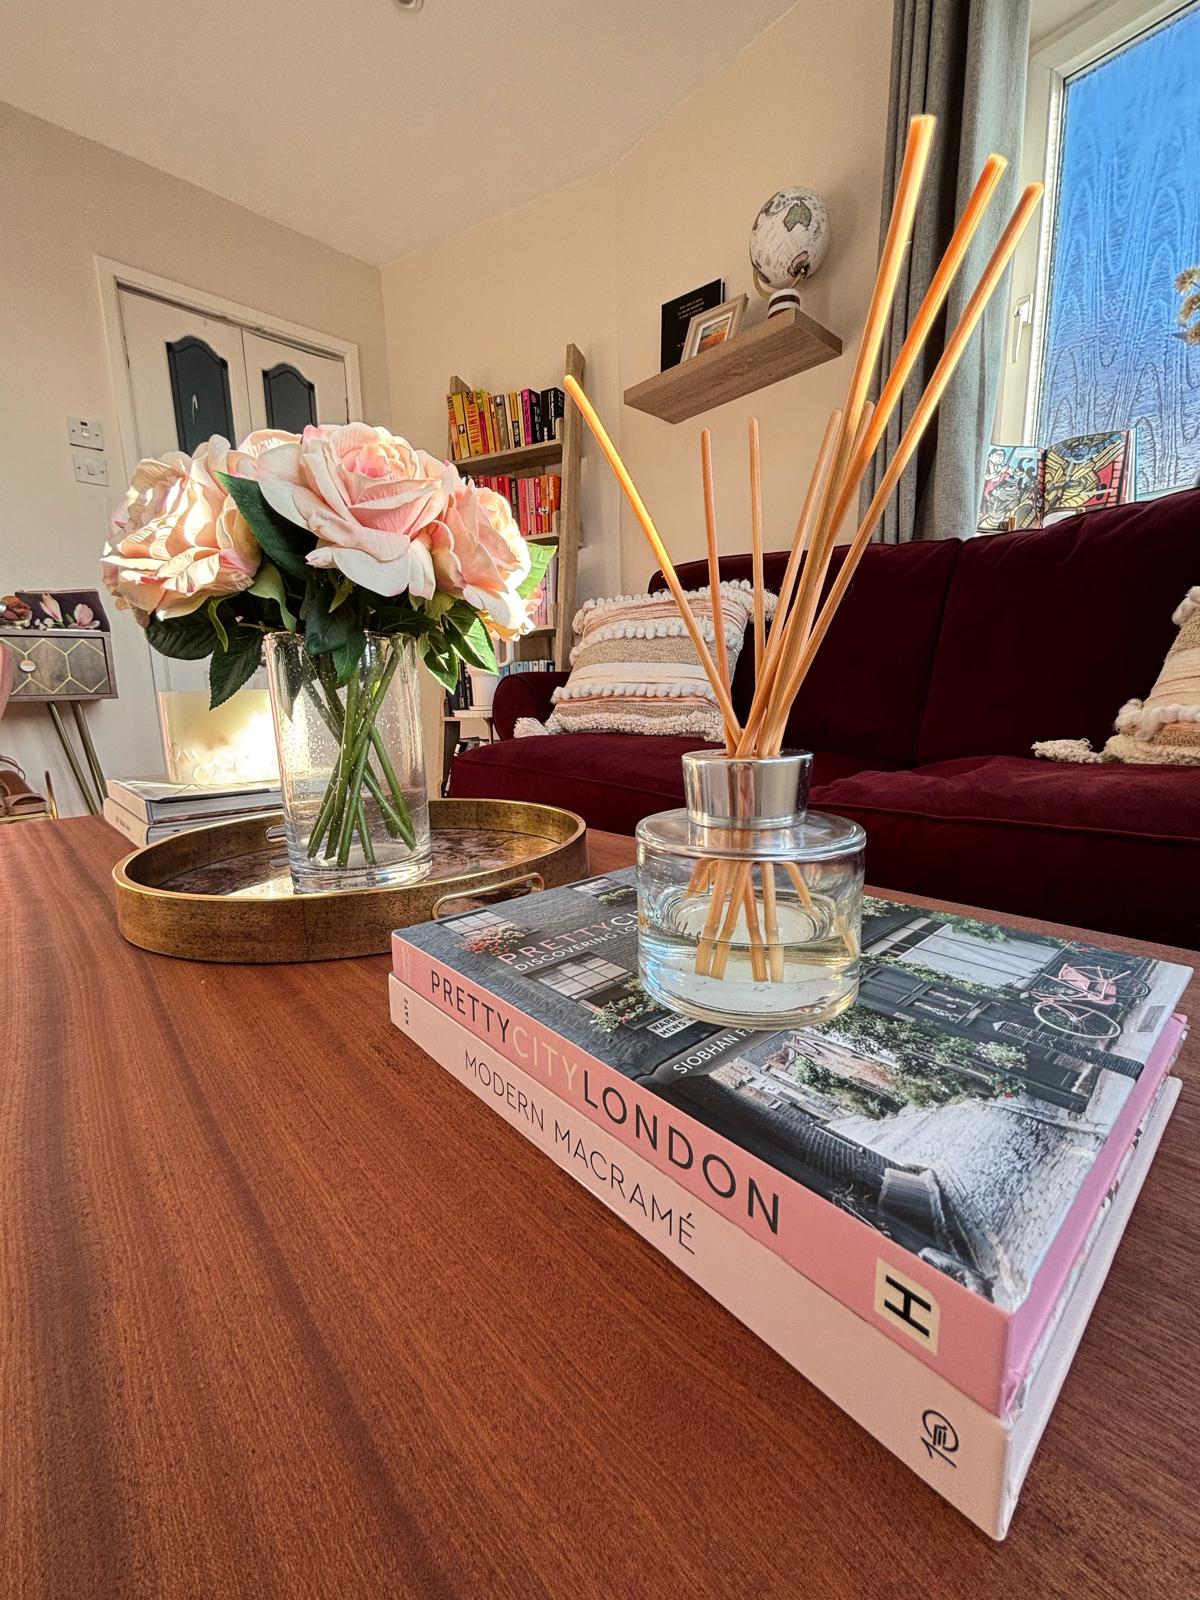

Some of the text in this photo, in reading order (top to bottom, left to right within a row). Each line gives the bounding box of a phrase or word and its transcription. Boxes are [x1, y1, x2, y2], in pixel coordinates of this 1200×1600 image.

[466, 409, 481, 444] HAMILTON
[513, 932, 618, 971] DISCOVERING
[659, 1021, 687, 1037] MEWS
[673, 1033, 740, 1075] SIOBHAN
[464, 1049, 697, 1256] MODERN MACRAMÉ
[883, 1274, 932, 1338] H
